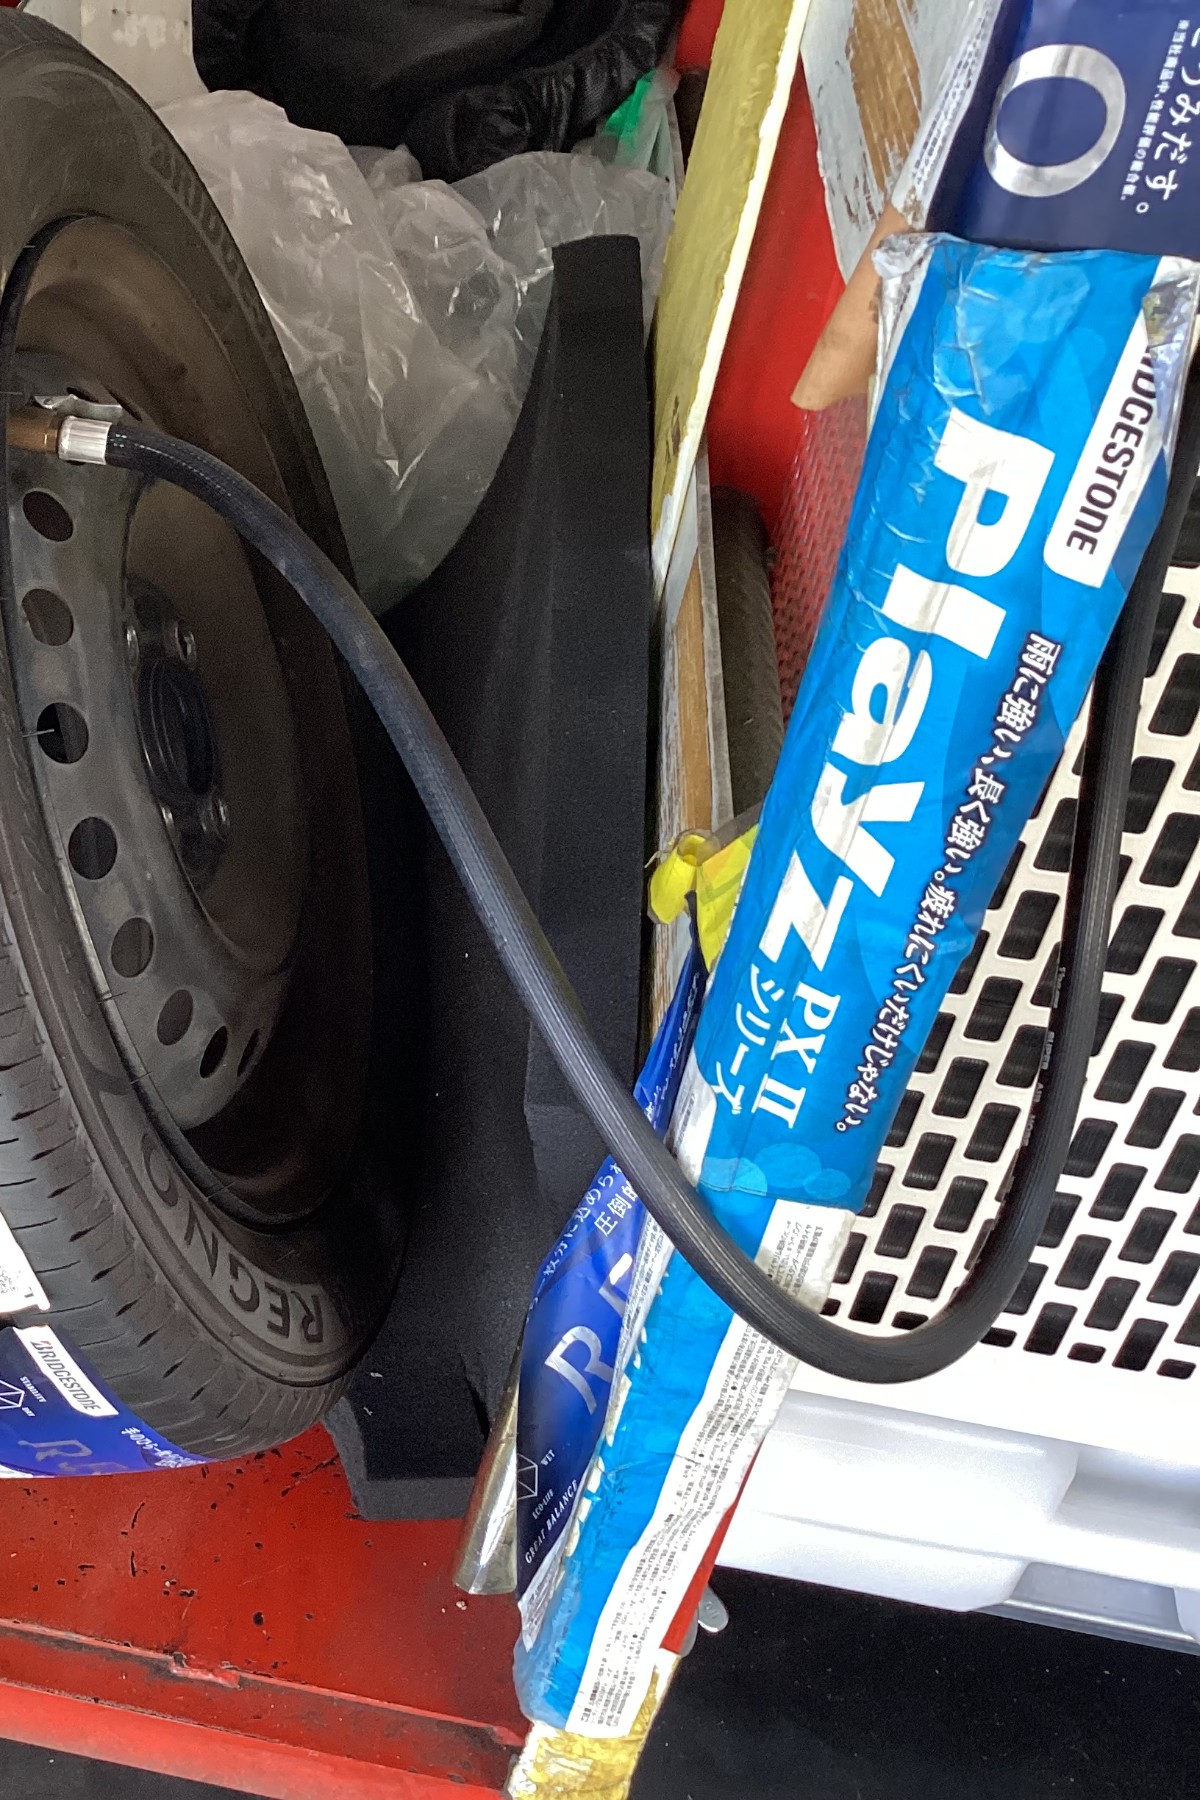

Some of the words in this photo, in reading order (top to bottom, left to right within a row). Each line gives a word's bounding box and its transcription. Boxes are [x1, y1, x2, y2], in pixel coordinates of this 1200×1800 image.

[759, 407, 1056, 972] Playz
[712, 963, 784, 1116] シリーズ
[29, 1340, 102, 1412] BRIDGESTONE
[540, 1449, 557, 1469] WET
[524, 1523, 548, 1565] GREAT
[546, 1479, 579, 1526] BALANCE
